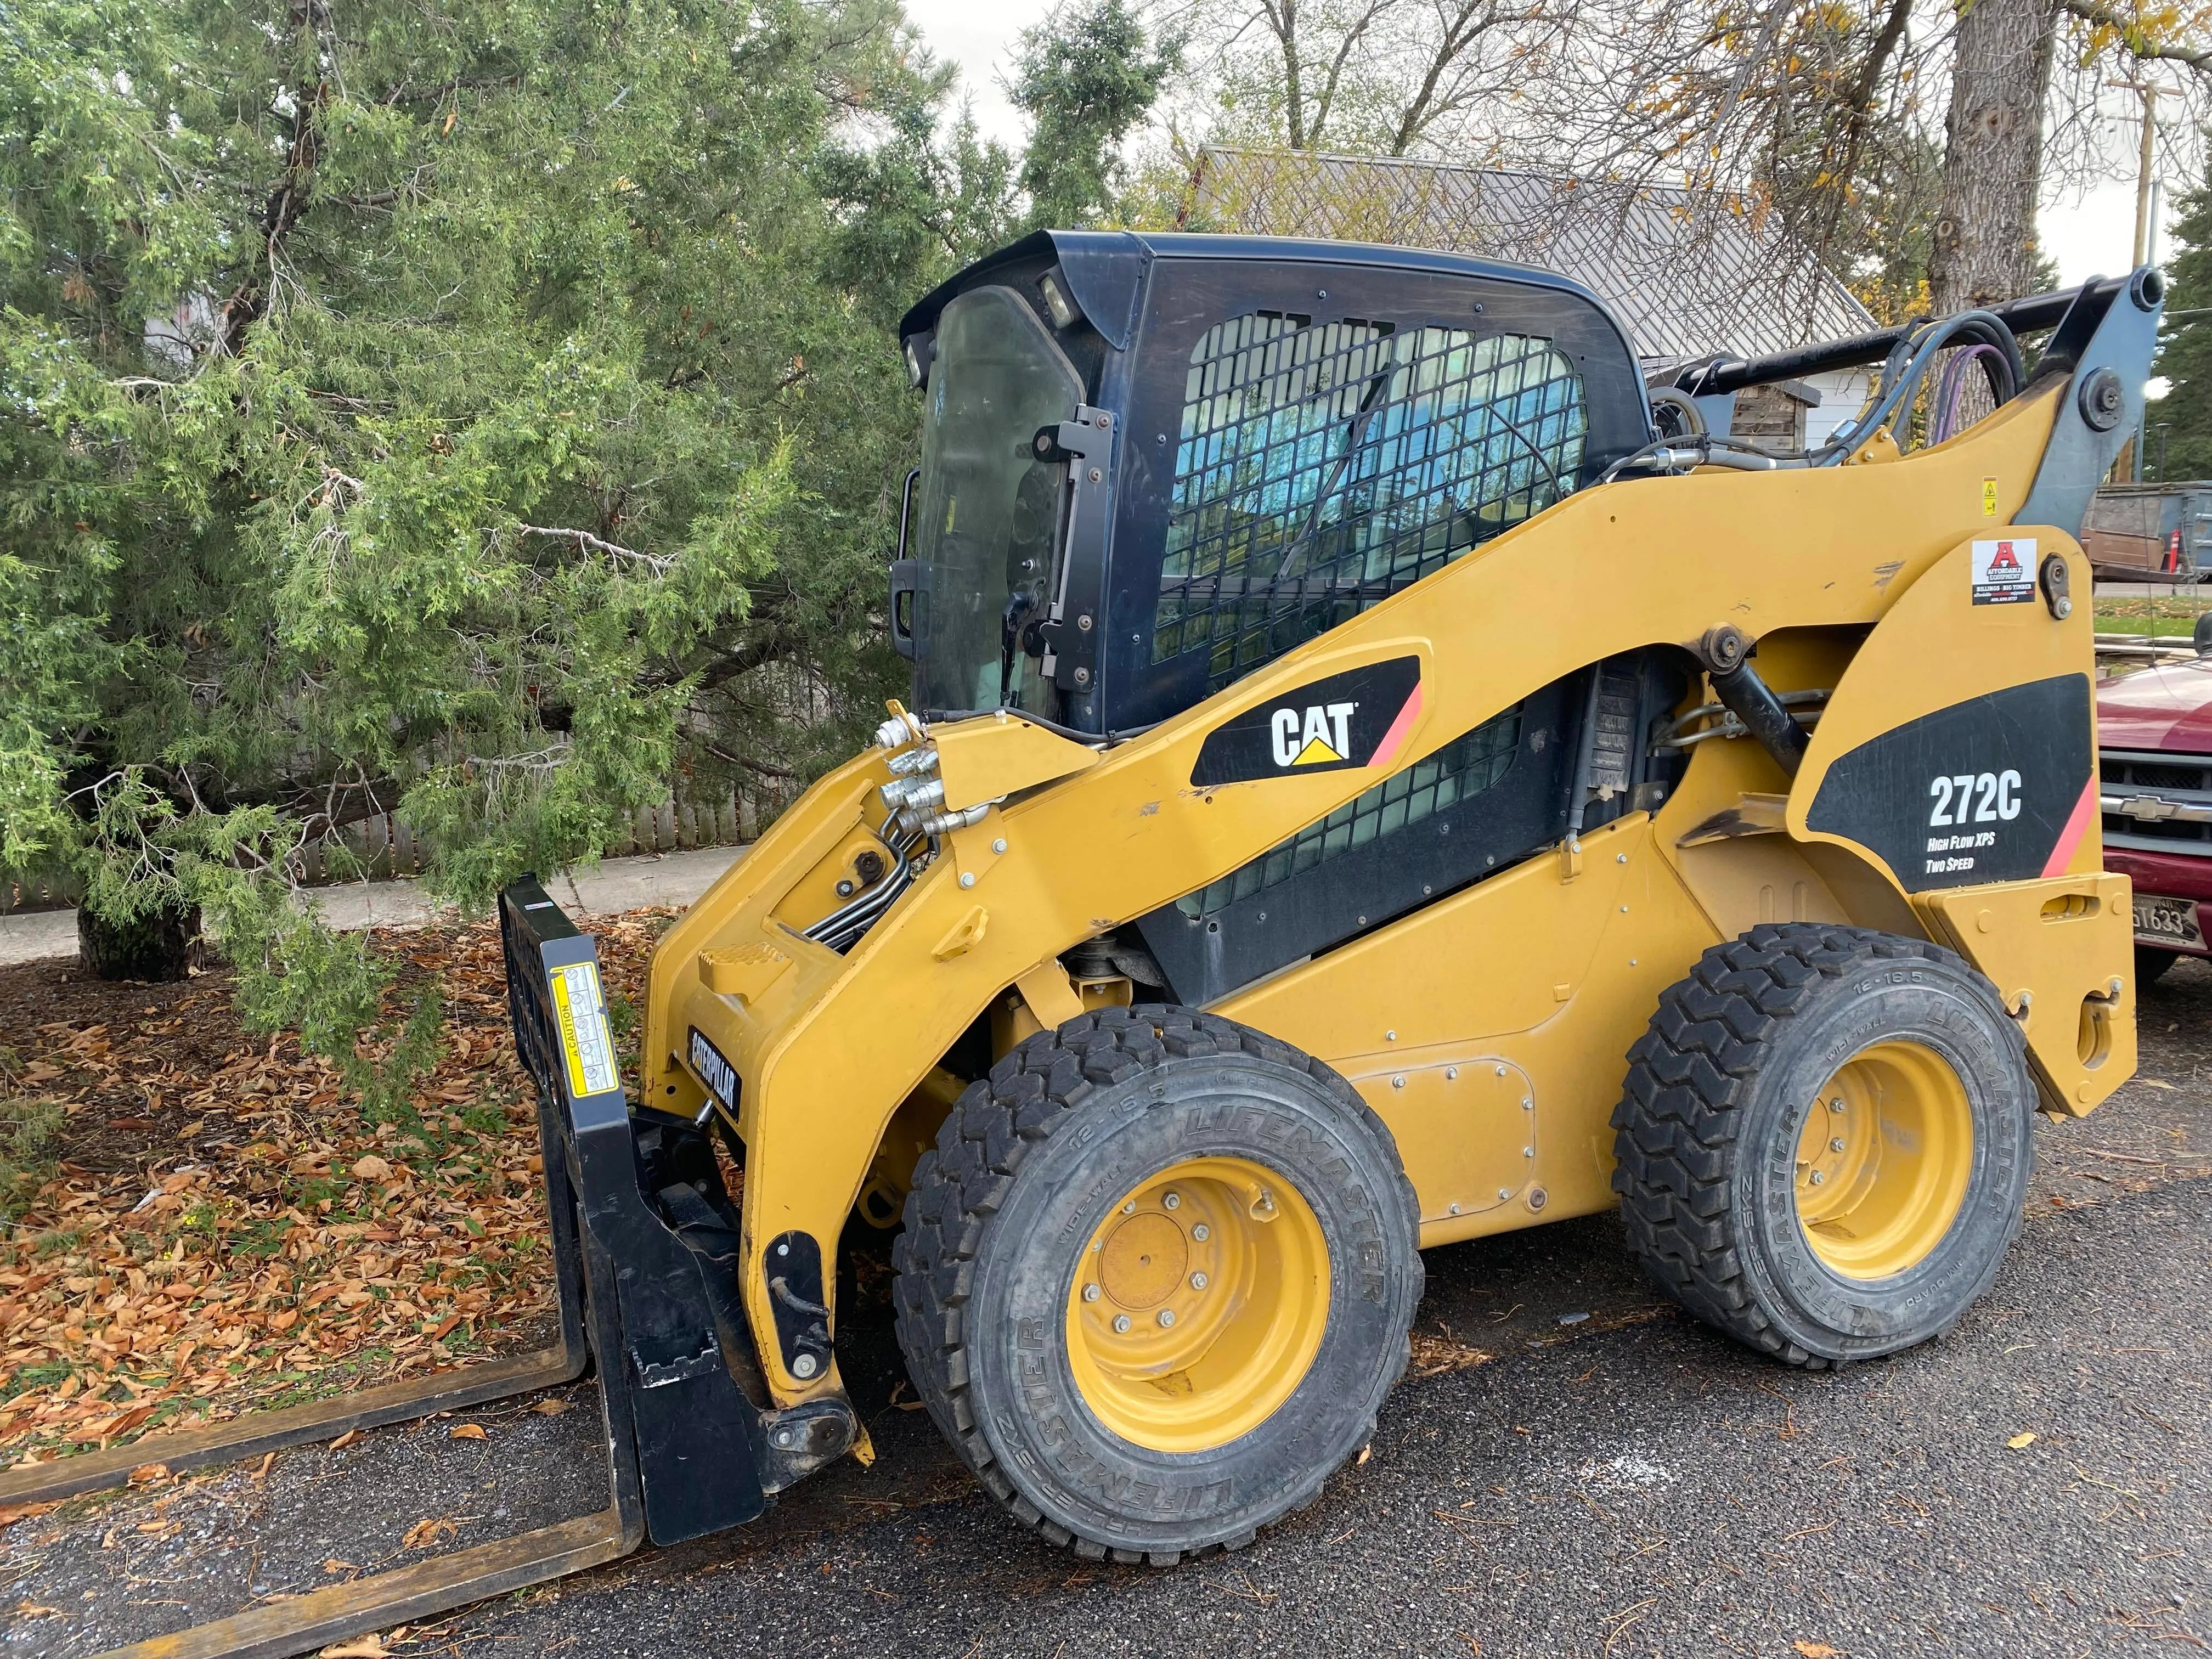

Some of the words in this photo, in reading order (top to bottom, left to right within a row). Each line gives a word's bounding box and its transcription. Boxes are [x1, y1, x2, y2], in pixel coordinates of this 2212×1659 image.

[1990, 541, 2019, 569] A
[1271, 702, 1355, 767] CAT
[1930, 769, 2022, 827] 272C
[1975, 831, 1996, 847] XPS
[1853, 971, 1922, 995] 12-16.5
[561, 1005, 577, 1049] CAUTION
[692, 1031, 735, 1110] CATERPILLAR
[1068, 1082, 1166, 1150] 12-16.5
[1926, 1001, 2016, 1222] LIFEMASTER
[1186, 1104, 1386, 1305] LIFEMASTER
[1769, 1103, 1866, 1328] LIFEMASTER
[1017, 1316, 1233, 1514] LIFEMASTER
